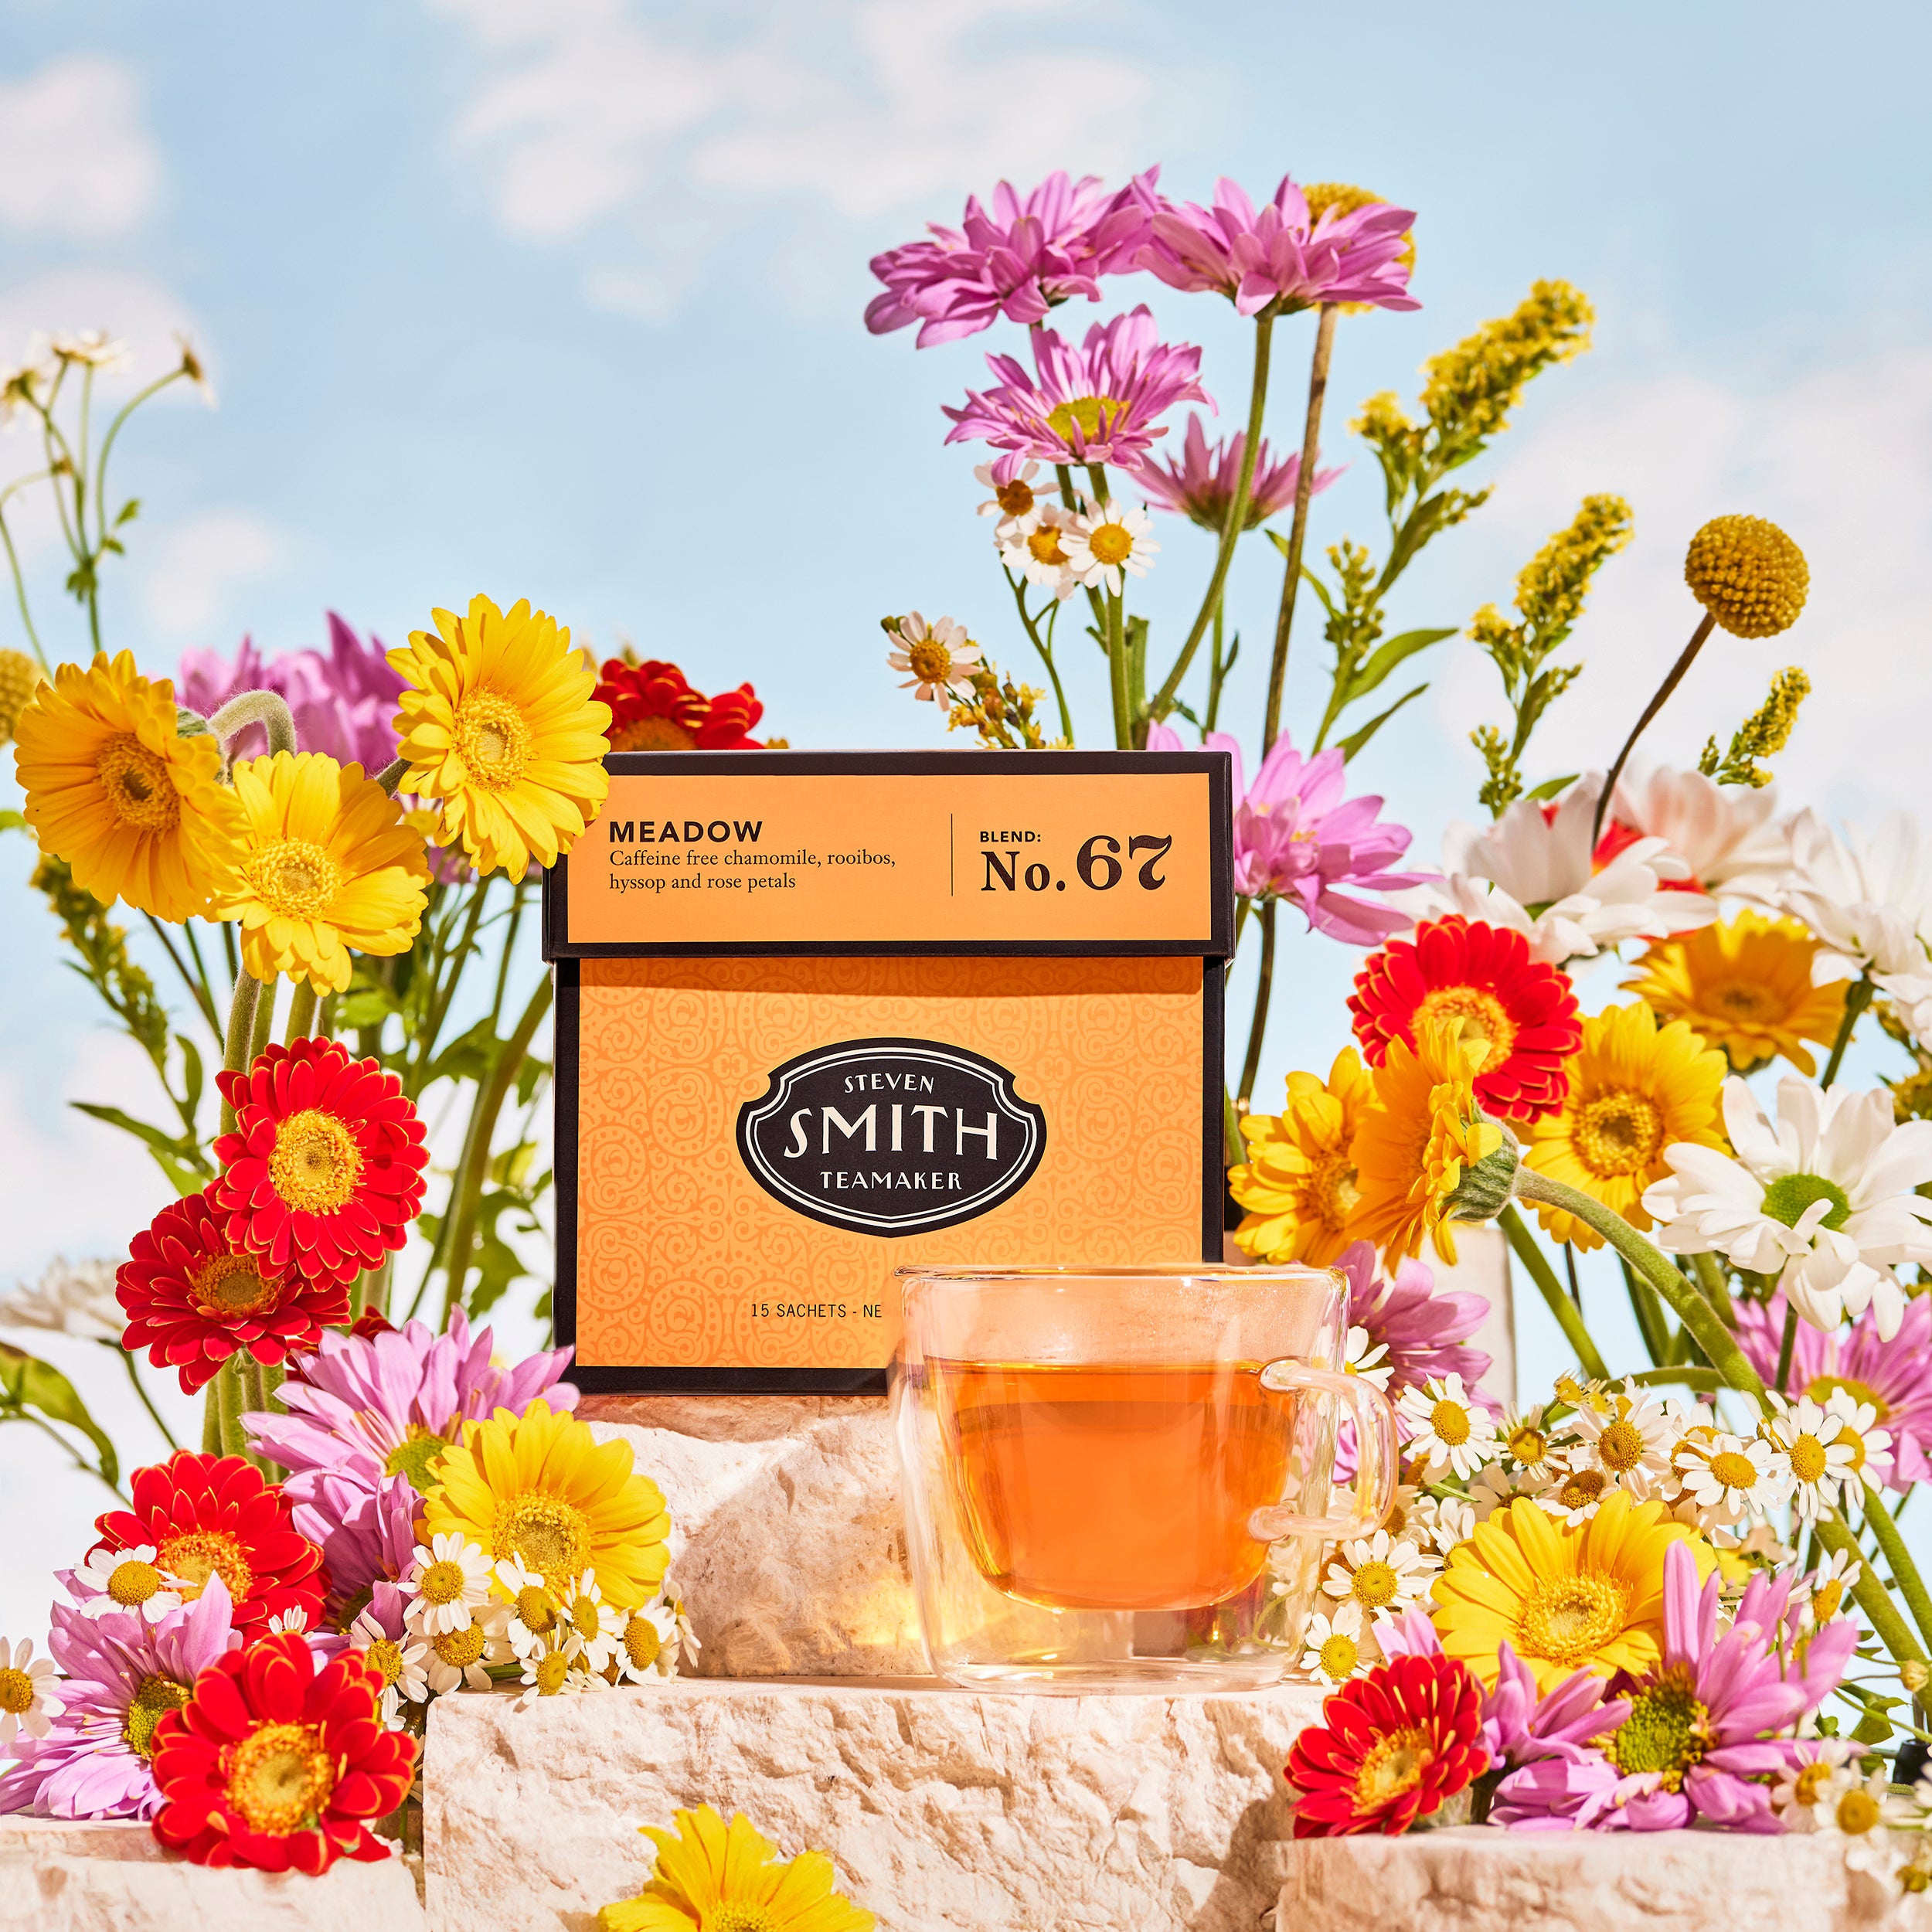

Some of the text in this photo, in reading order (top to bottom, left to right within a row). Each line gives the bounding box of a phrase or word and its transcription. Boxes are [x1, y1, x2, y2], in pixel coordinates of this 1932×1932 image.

[610, 820, 764, 843] MEADOW
[980, 831, 1041, 843] BLEND:
[610, 849, 896, 868] Caffeine free chamomile, rooibos,
[981, 834, 1172, 892] No. 67
[609, 872, 796, 893] hyssop and rose petals
[844, 1073, 934, 1094] STEVEN
[784, 1104, 998, 1161] SMITH
[819, 1171, 962, 1191] TEAMAKER
[751, 1303, 770, 1318] 15
[776, 1303, 846, 1318] SACHETS
[863, 1304, 883, 1318] NE
